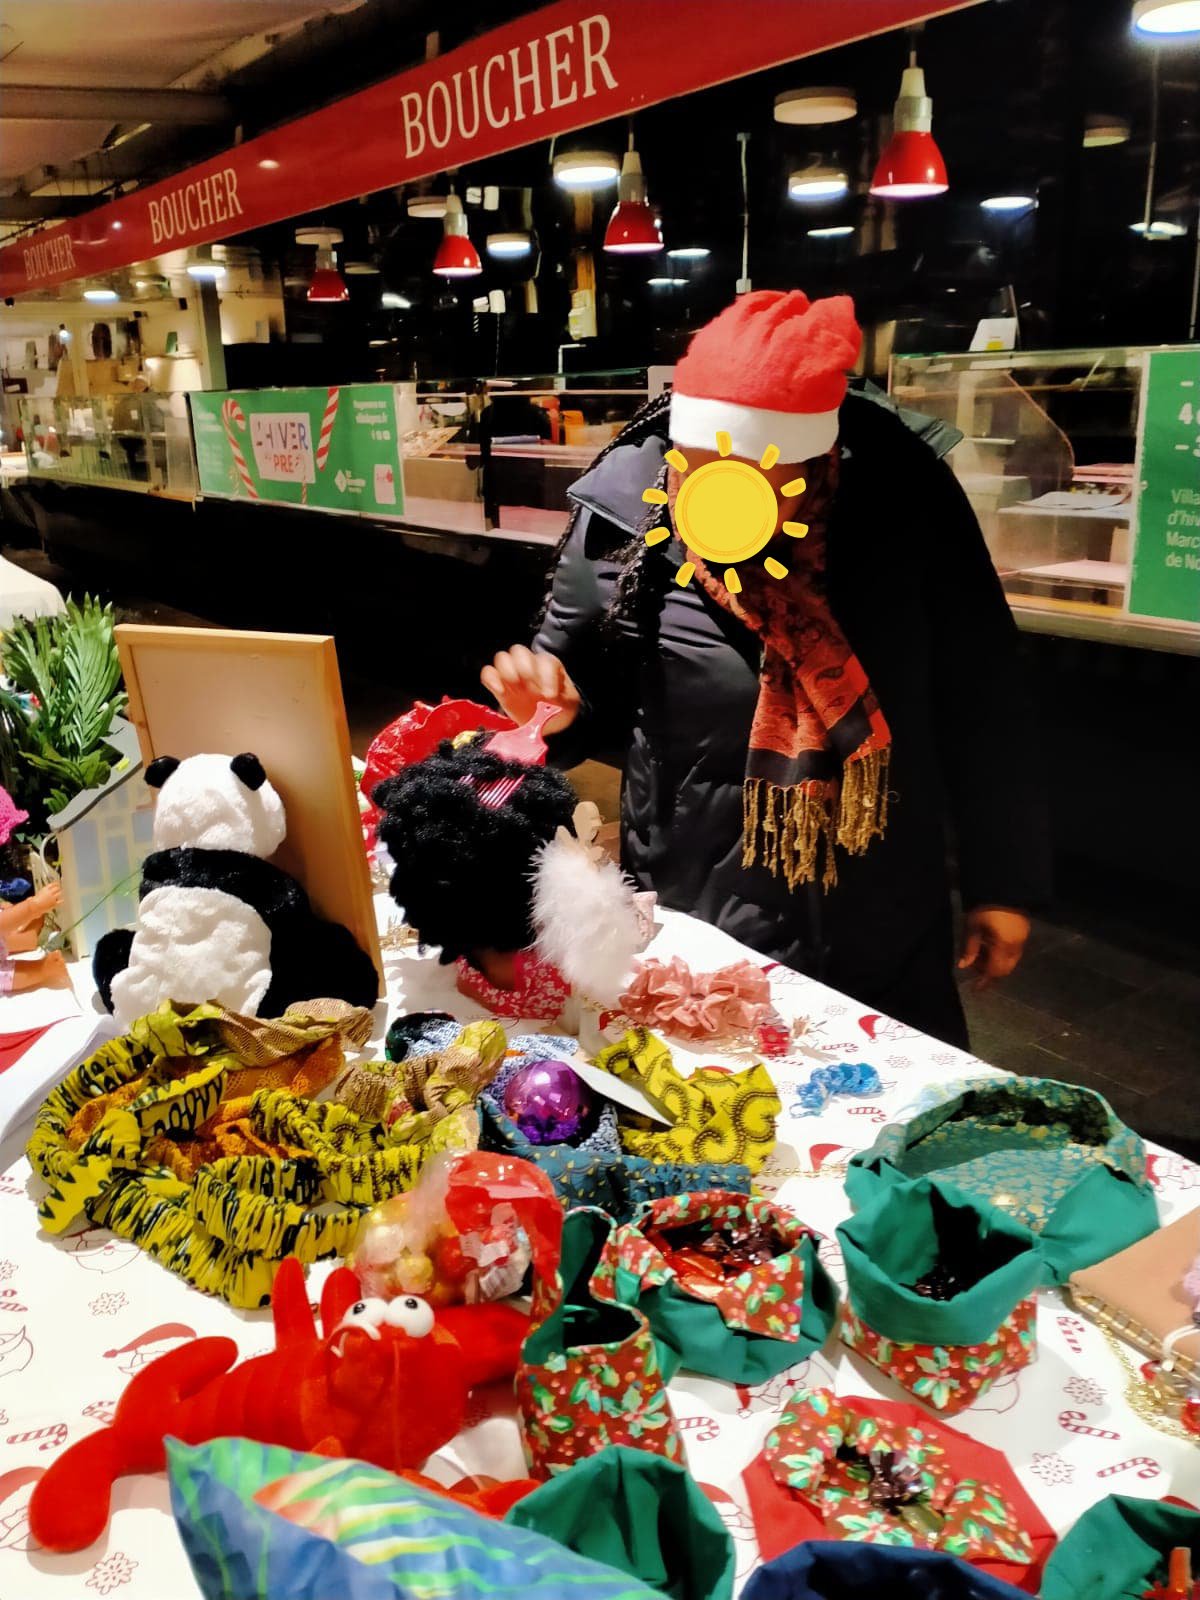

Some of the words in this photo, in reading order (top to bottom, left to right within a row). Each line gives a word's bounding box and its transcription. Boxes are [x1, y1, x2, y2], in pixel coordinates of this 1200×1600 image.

[400, 14, 619, 159] BOUCHER
[148, 168, 243, 244] BOUCHER
[23, 234, 76, 281] BOUCHER
[1165, 551, 1183, 568] de
